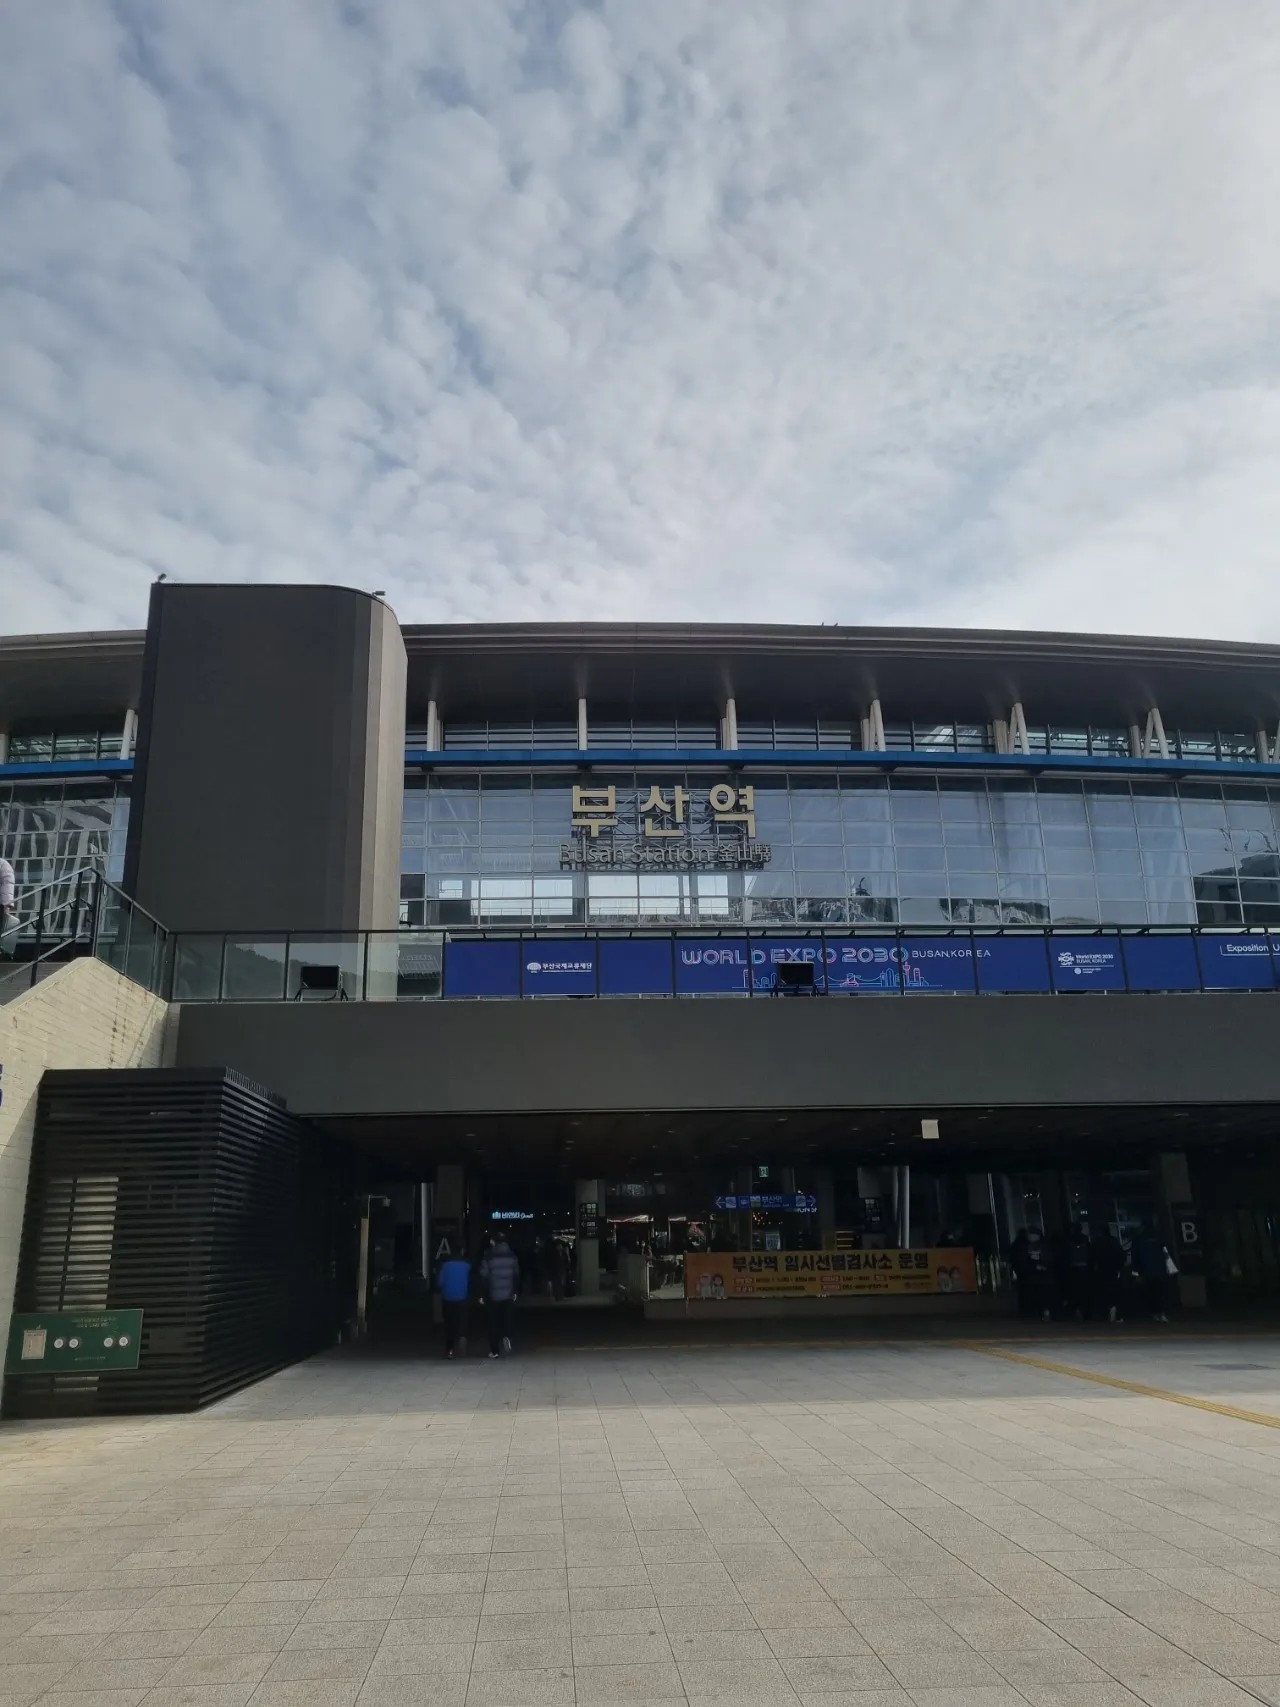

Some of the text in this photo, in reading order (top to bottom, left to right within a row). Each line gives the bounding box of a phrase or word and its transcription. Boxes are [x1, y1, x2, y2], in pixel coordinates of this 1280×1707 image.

[571, 784, 756, 838] 부산역
[559, 843, 626, 864] Busan
[631, 844, 712, 864] Station
[681, 948, 766, 965] WORLD
[770, 948, 837, 964] EXPO
[841, 947, 909, 963] 2030
[1226, 944, 1269, 953] Exposition
[1180, 1221, 1199, 1244] B
[435, 1237, 451, 1260] A
[732, 1256, 778, 1273] 부산역
[899, 1253, 929, 1269] 운영
